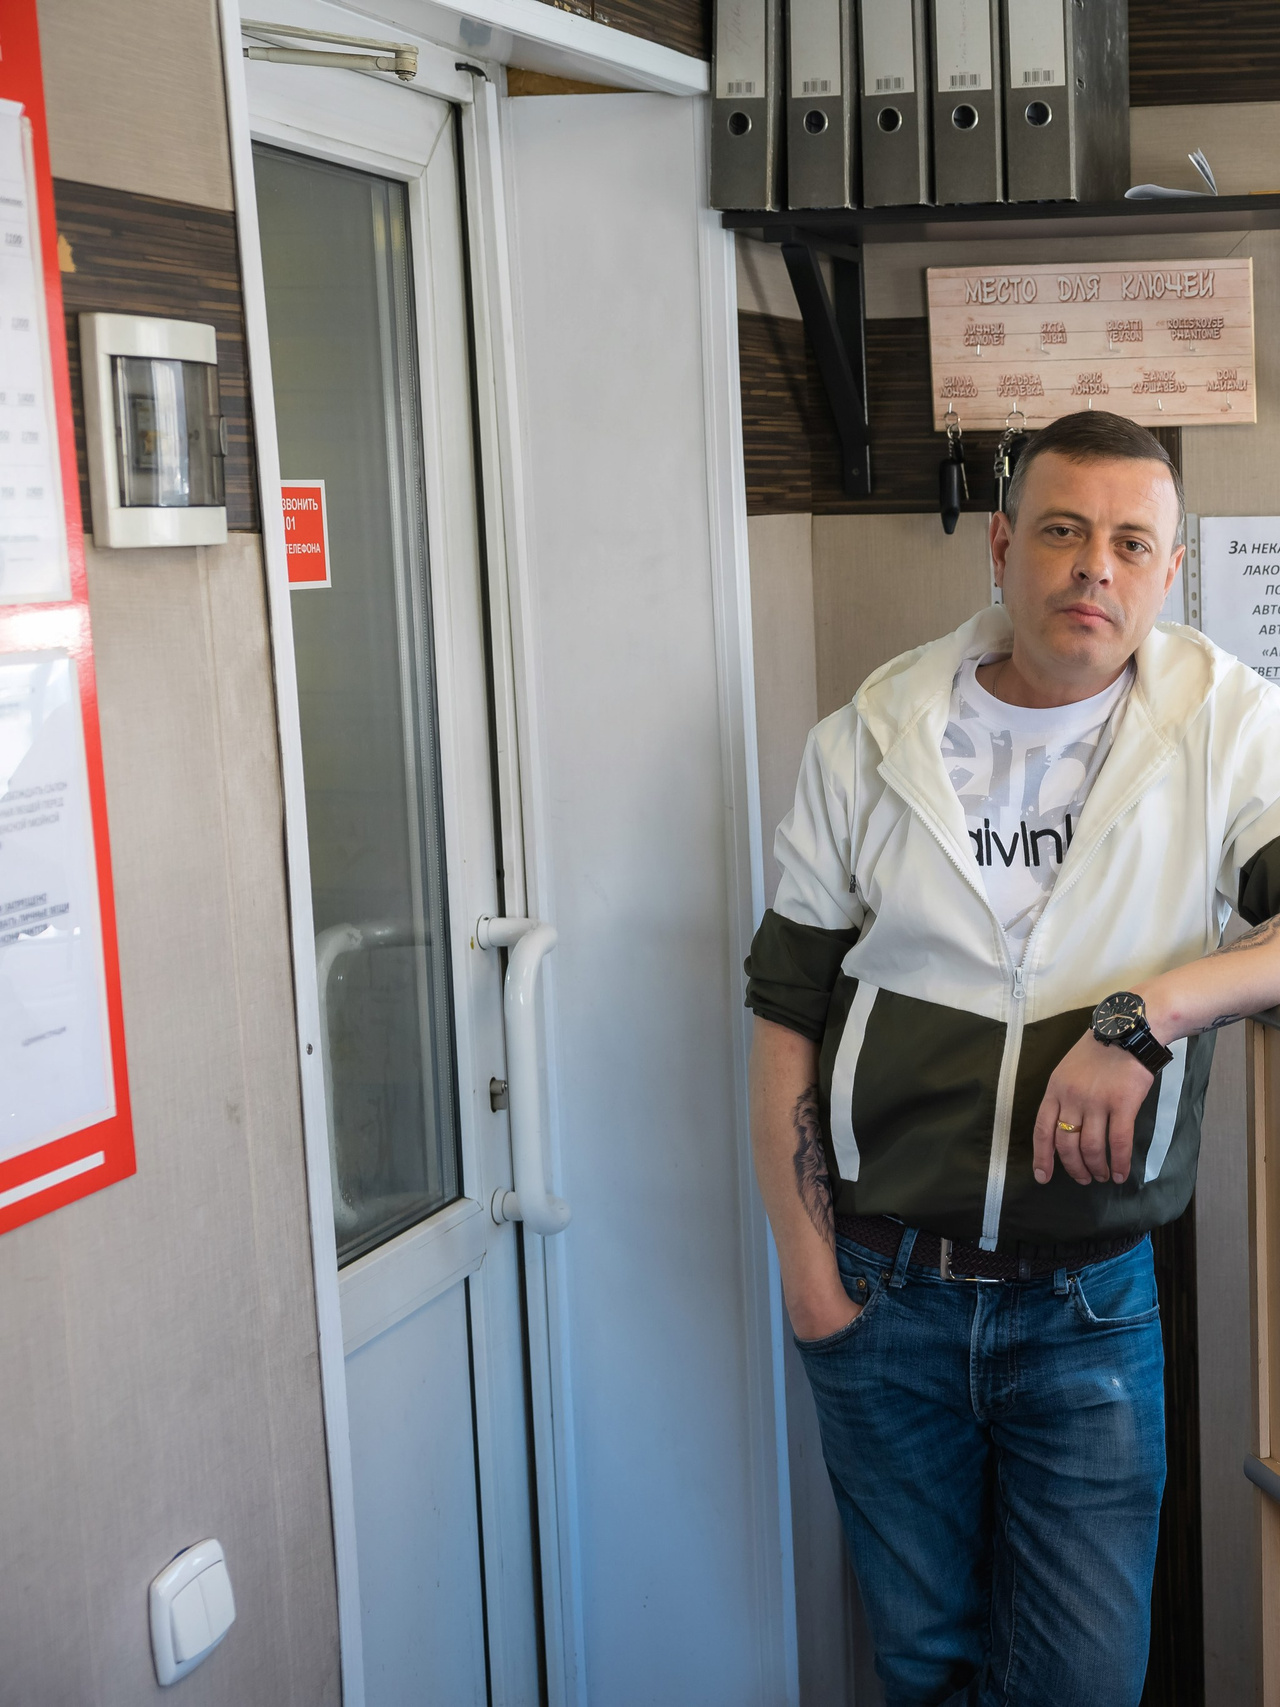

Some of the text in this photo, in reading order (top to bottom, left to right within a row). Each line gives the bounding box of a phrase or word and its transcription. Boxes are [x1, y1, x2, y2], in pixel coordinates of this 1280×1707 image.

[965, 269, 1215, 304] МЕСТО ДЛЯ КЛЮЧЕЙ
[1106, 319, 1143, 331] BUGATTI
[1041, 332, 1067, 344] DUBAI
[1107, 330, 1143, 342] VEYRON
[1077, 372, 1102, 384] ОФИС
[1142, 370, 1176, 382] ЗАМОК
[1216, 369, 1237, 380] ДОМ
[940, 386, 978, 398] МОНАКО
[1071, 383, 1109, 395] ЛОНДОН
[1131, 381, 1187, 394] КУРШАВЕЛЬ
